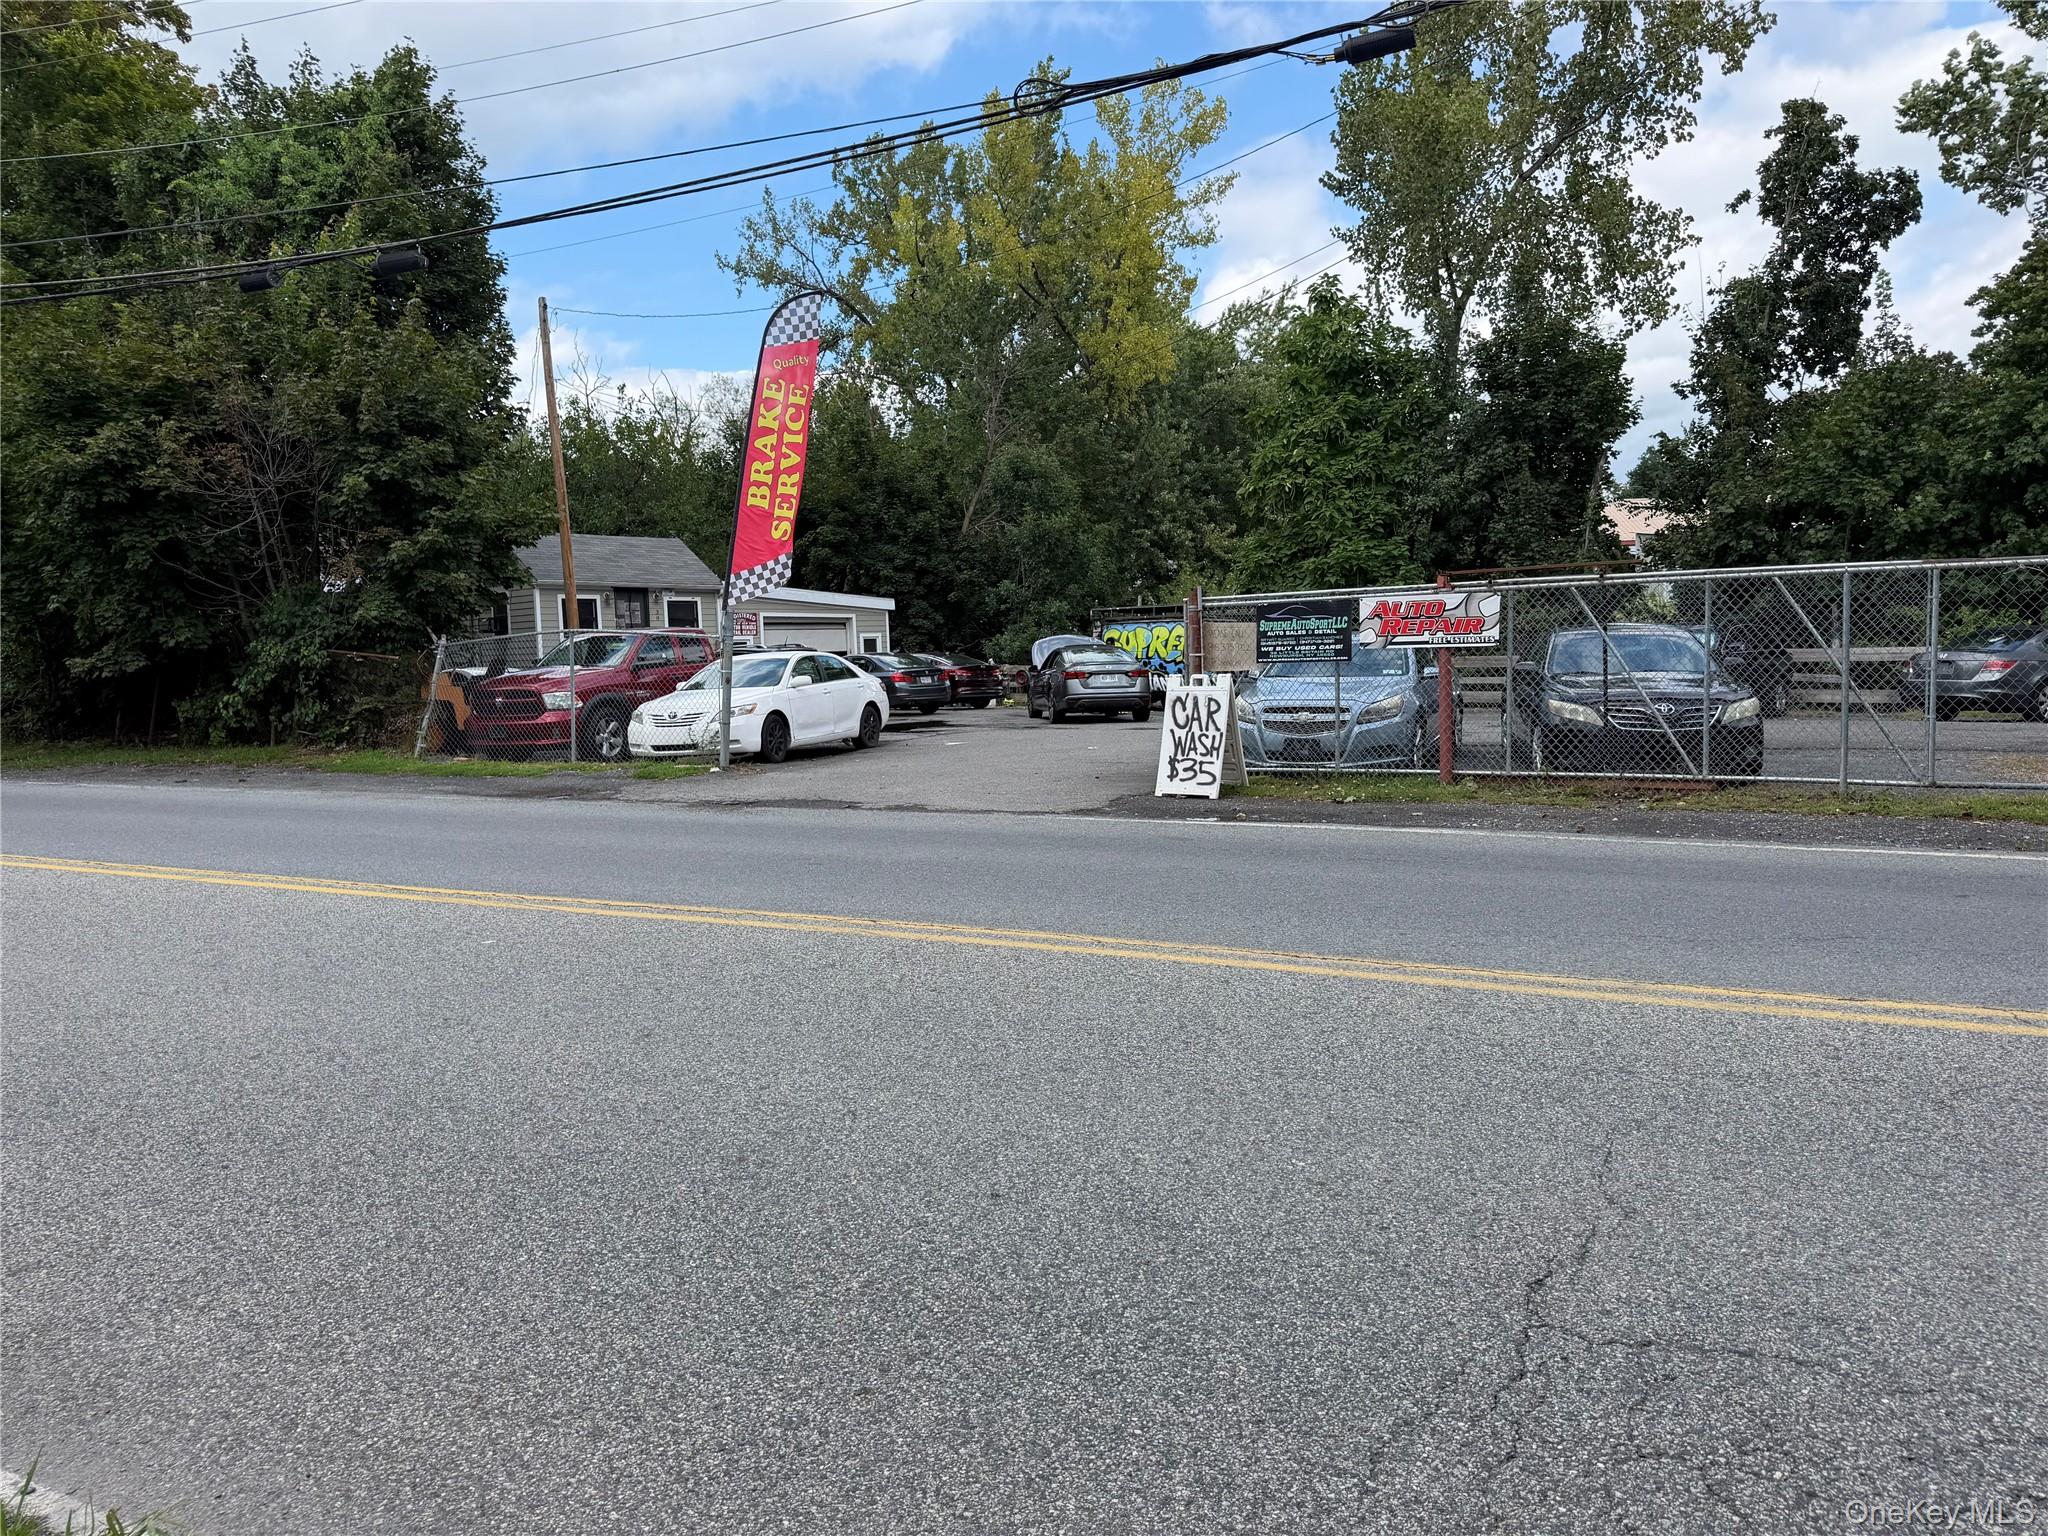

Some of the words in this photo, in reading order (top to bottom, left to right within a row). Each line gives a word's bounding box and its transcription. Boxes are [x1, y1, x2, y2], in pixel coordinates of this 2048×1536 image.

[773, 355, 809, 370] Quality
[747, 377, 786, 510] BRAKE
[771, 383, 810, 541] SERVICE
[1368, 600, 1446, 618] AUTO
[1377, 616, 1485, 637] REPAIR
[1103, 623, 1185, 663] SUPRE
[1171, 692, 1221, 732] CAR
[1170, 729, 1223, 760] WASH
[1166, 755, 1217, 785] $35
